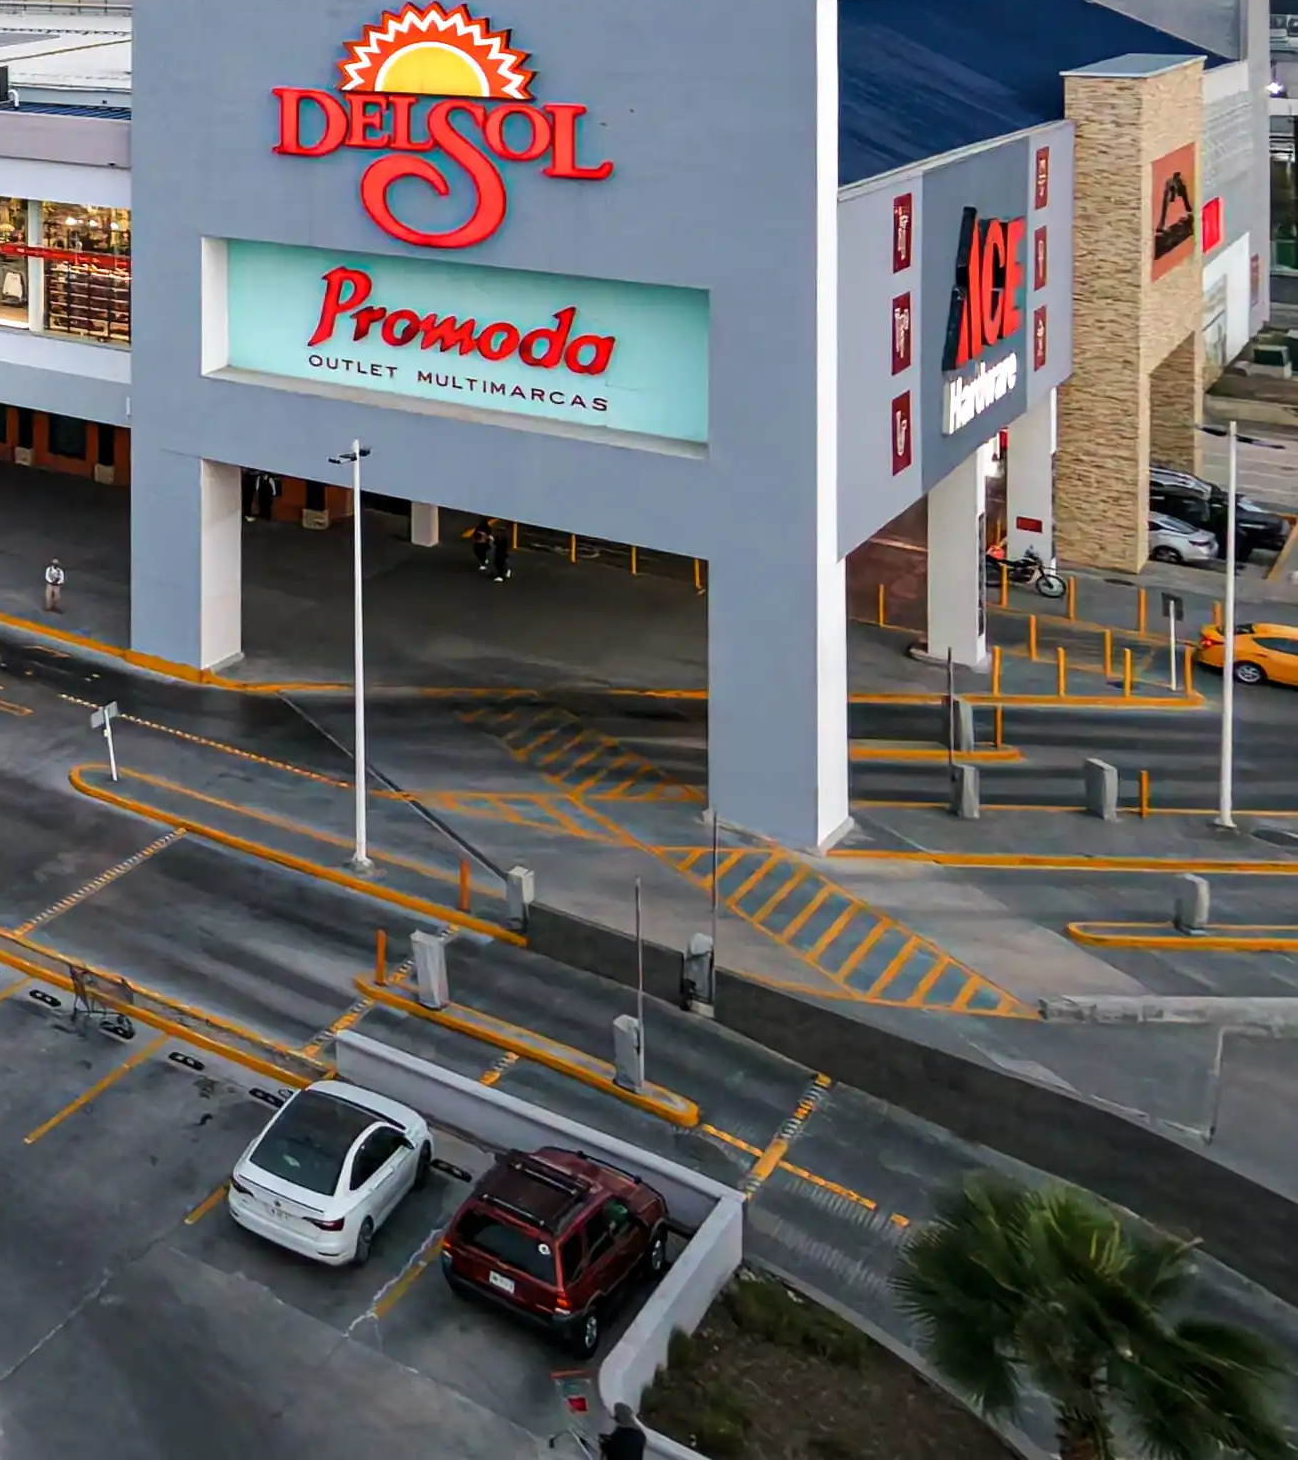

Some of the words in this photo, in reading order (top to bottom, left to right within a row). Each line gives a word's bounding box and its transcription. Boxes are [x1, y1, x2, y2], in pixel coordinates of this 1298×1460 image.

[308, 266, 616, 377] Promoda
[950, 208, 1025, 368] ACE
[309, 354, 398, 379] OUTLET
[417, 372, 609, 413] MULTIMARCAS
[946, 352, 1018, 436] Hardware
